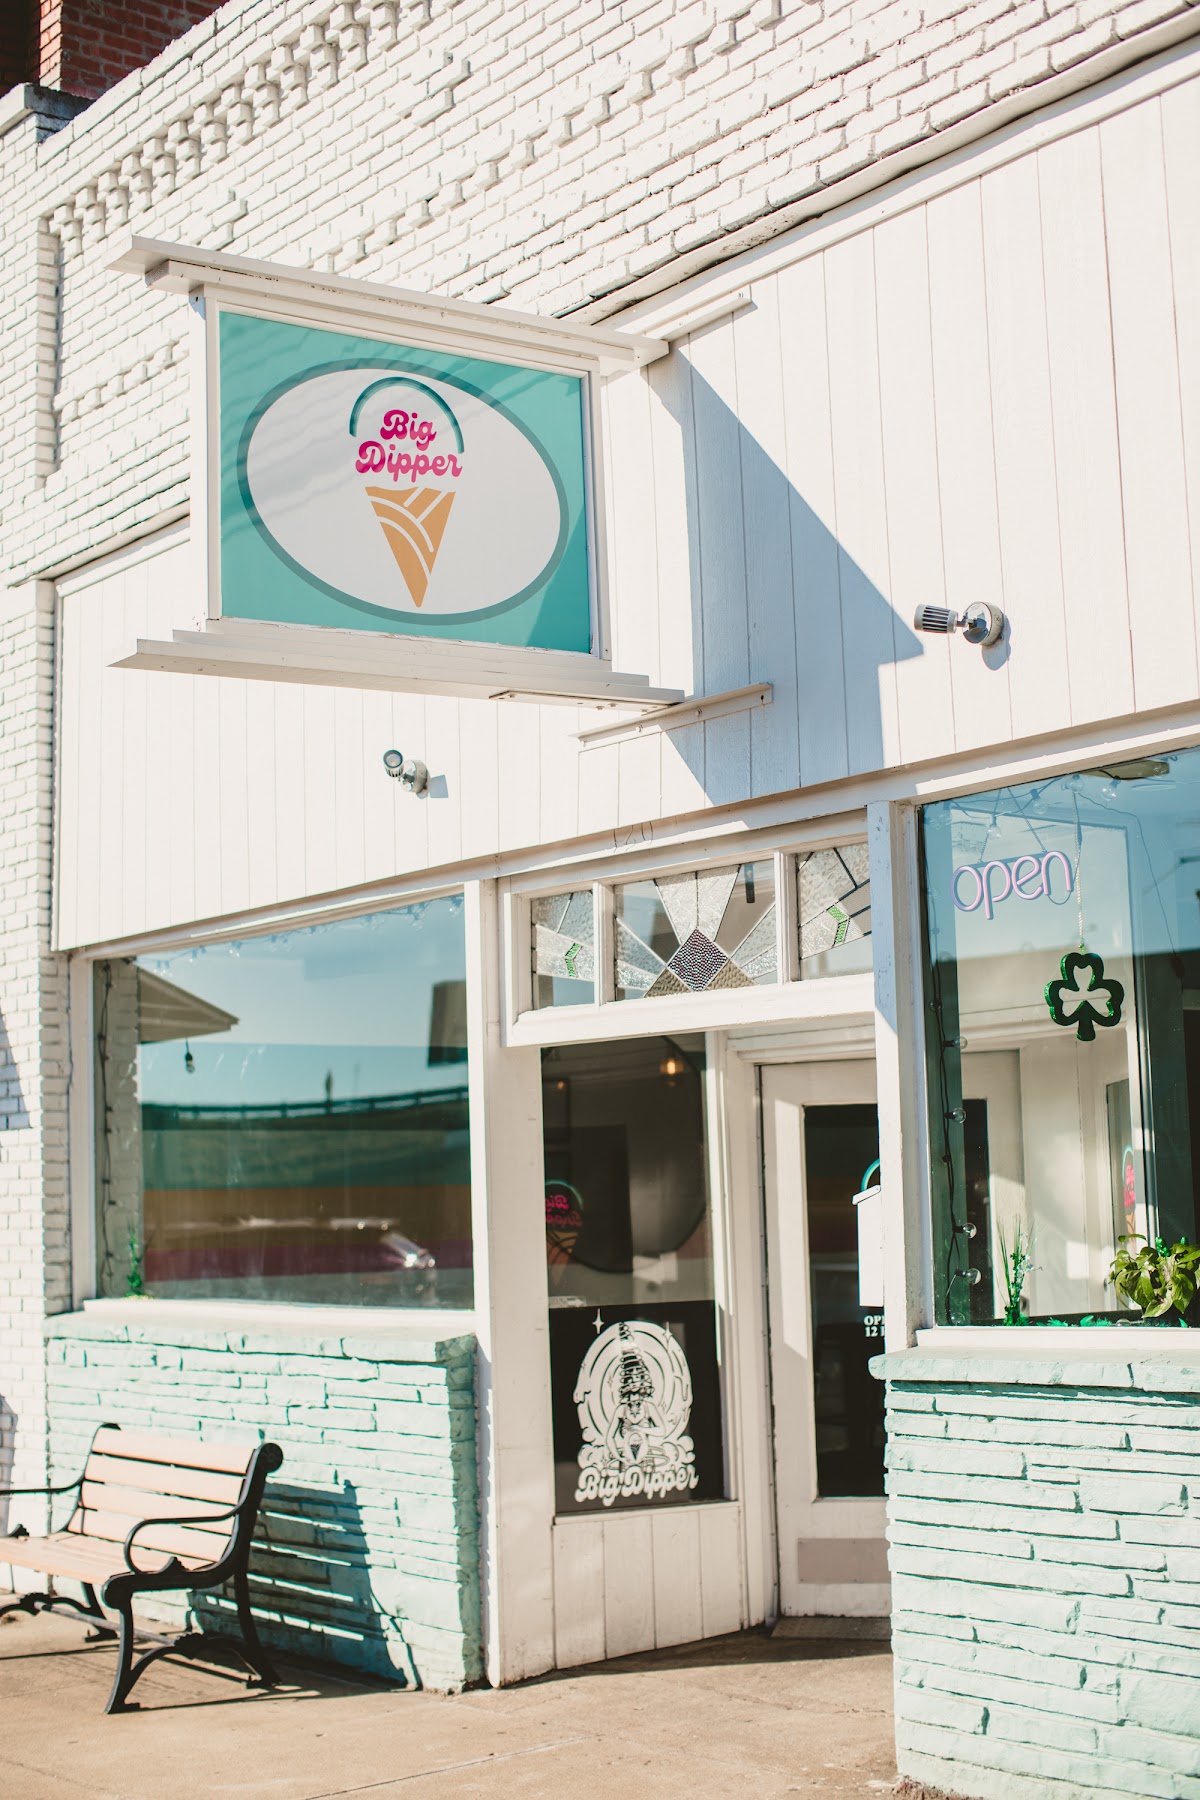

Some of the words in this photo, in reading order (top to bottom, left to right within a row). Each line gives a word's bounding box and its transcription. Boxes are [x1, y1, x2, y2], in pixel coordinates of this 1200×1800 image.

[380, 409, 437, 451] Big
[355, 440, 463, 483] Dipper
[950, 851, 1074, 920] open
[574, 1465, 623, 1507] Big
[621, 1464, 699, 1500] Dipper
